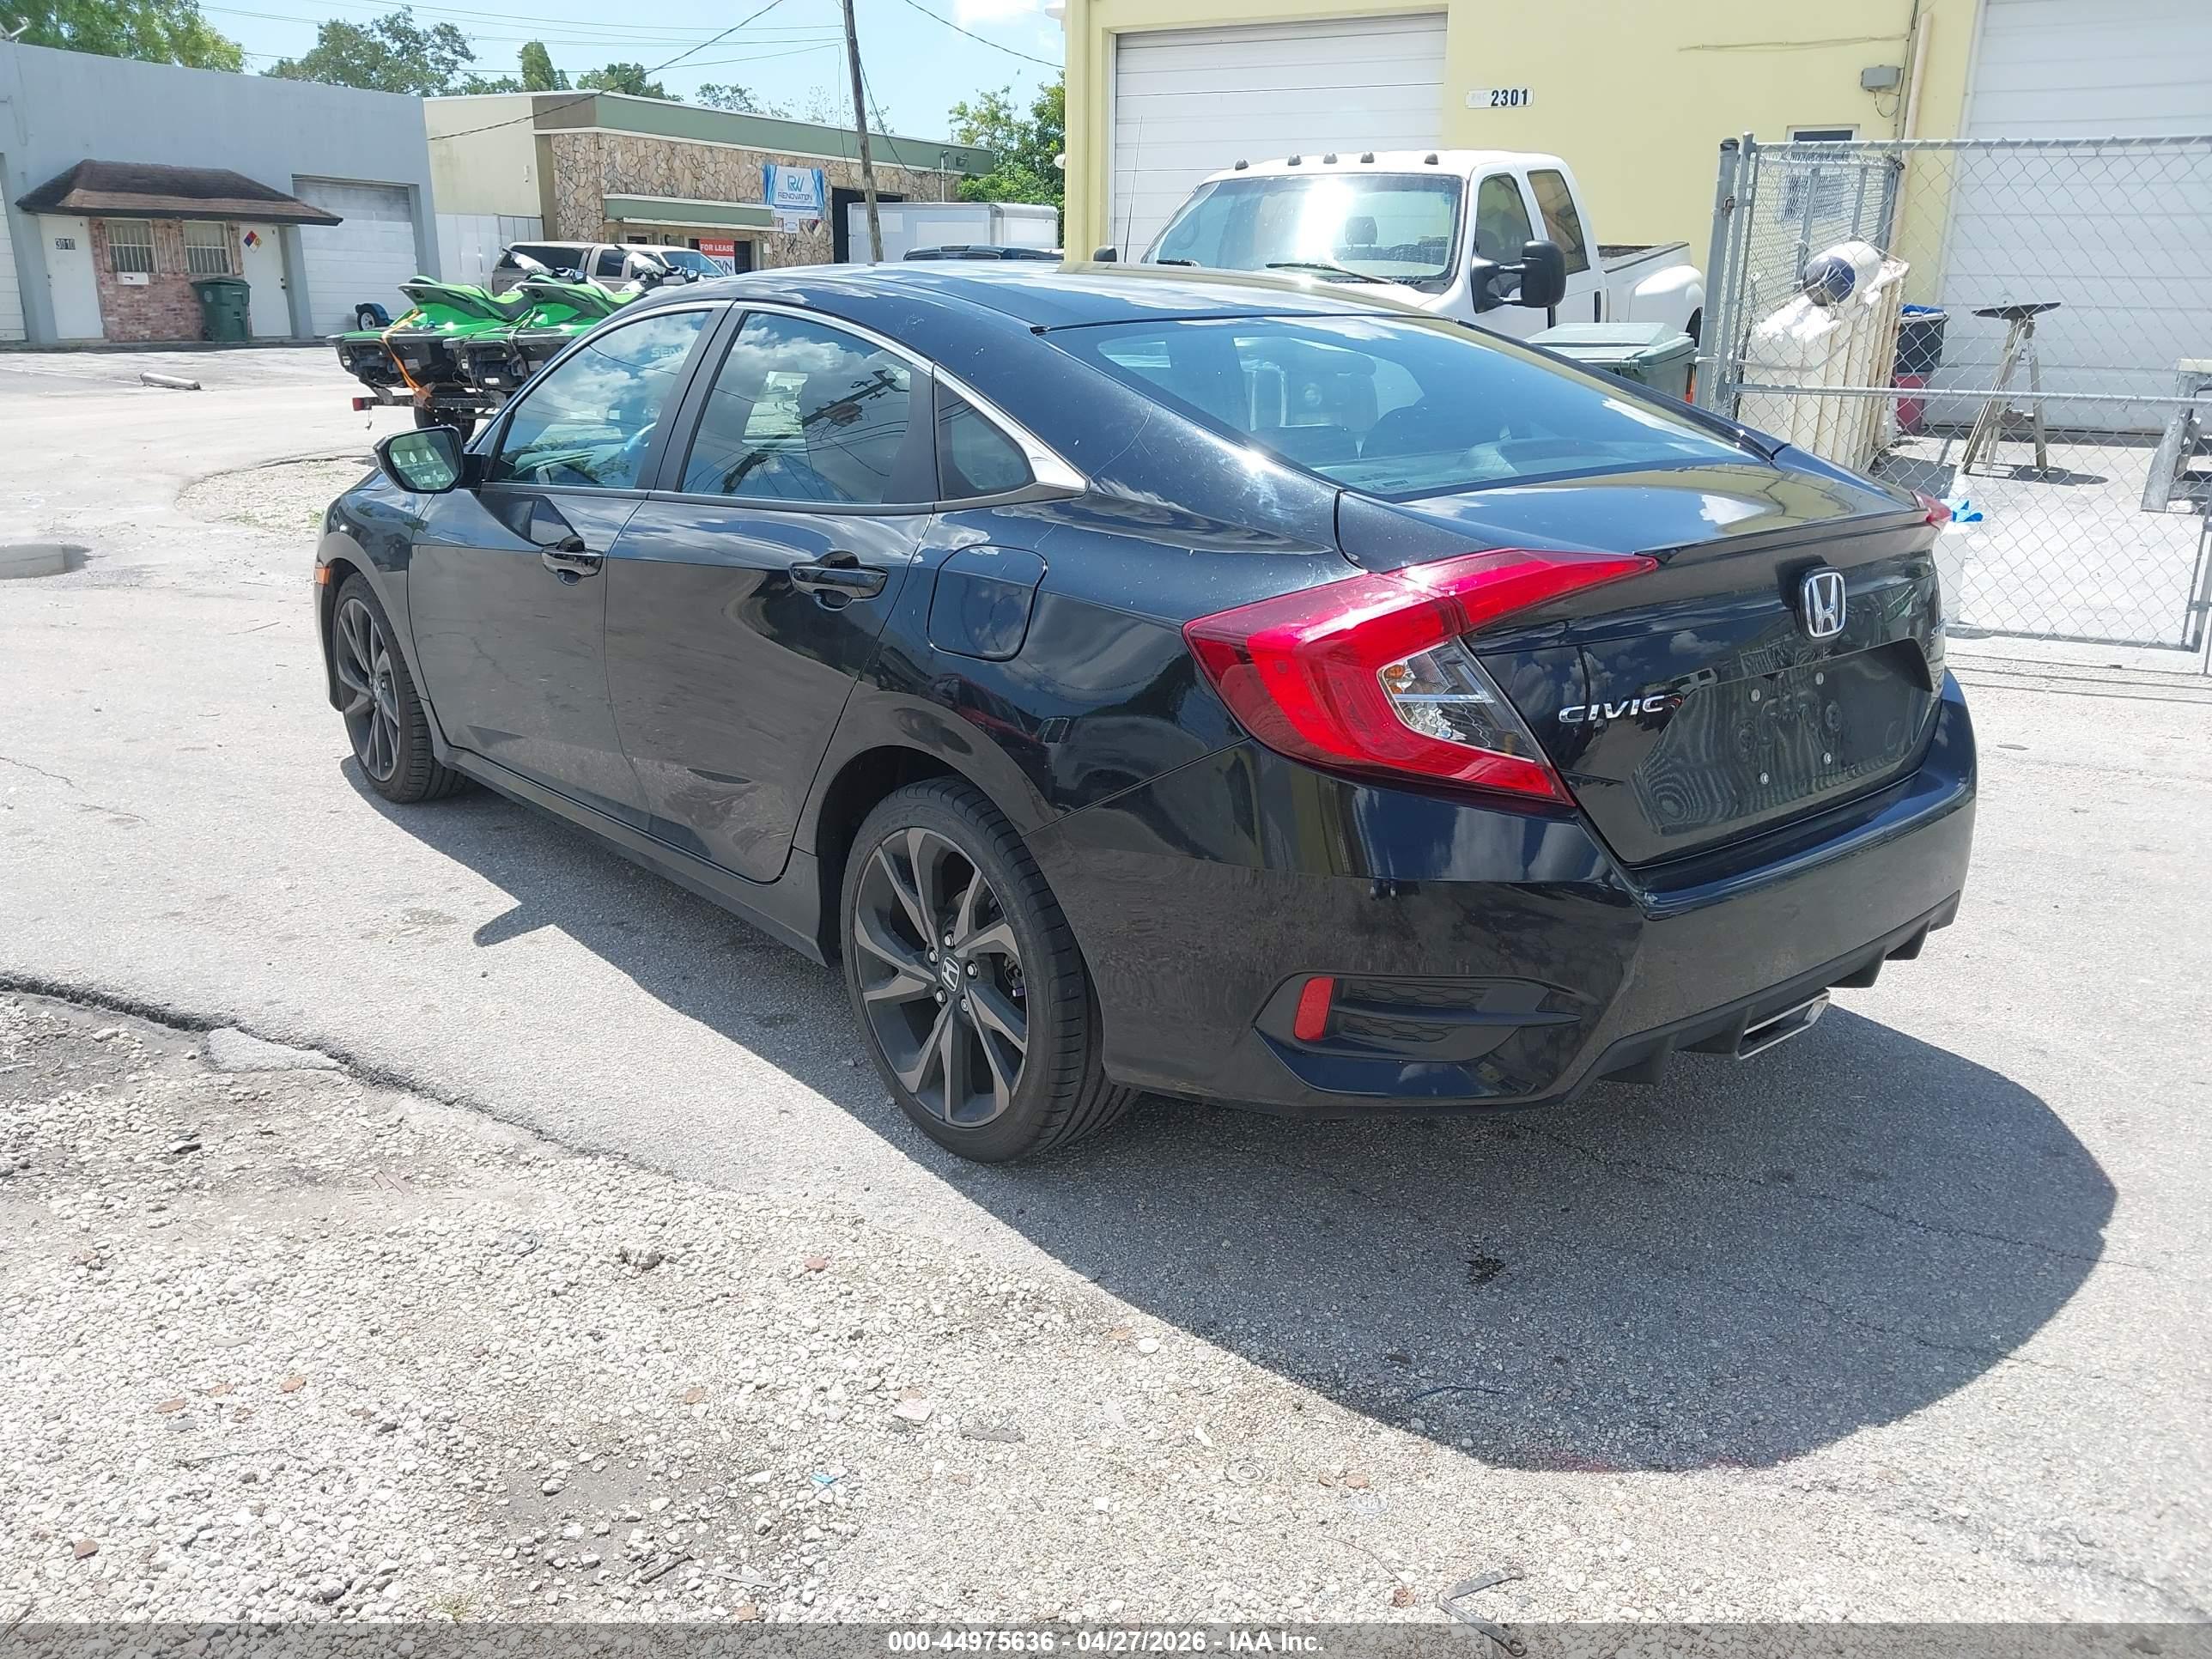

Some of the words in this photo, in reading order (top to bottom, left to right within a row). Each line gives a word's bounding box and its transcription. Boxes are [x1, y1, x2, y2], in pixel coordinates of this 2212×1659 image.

[1490, 88, 1528, 106] 2301
[777, 191, 813, 201] RENOVATION
[714, 244, 734, 252] LEASE
[1559, 695, 1665, 723] CIVIC
